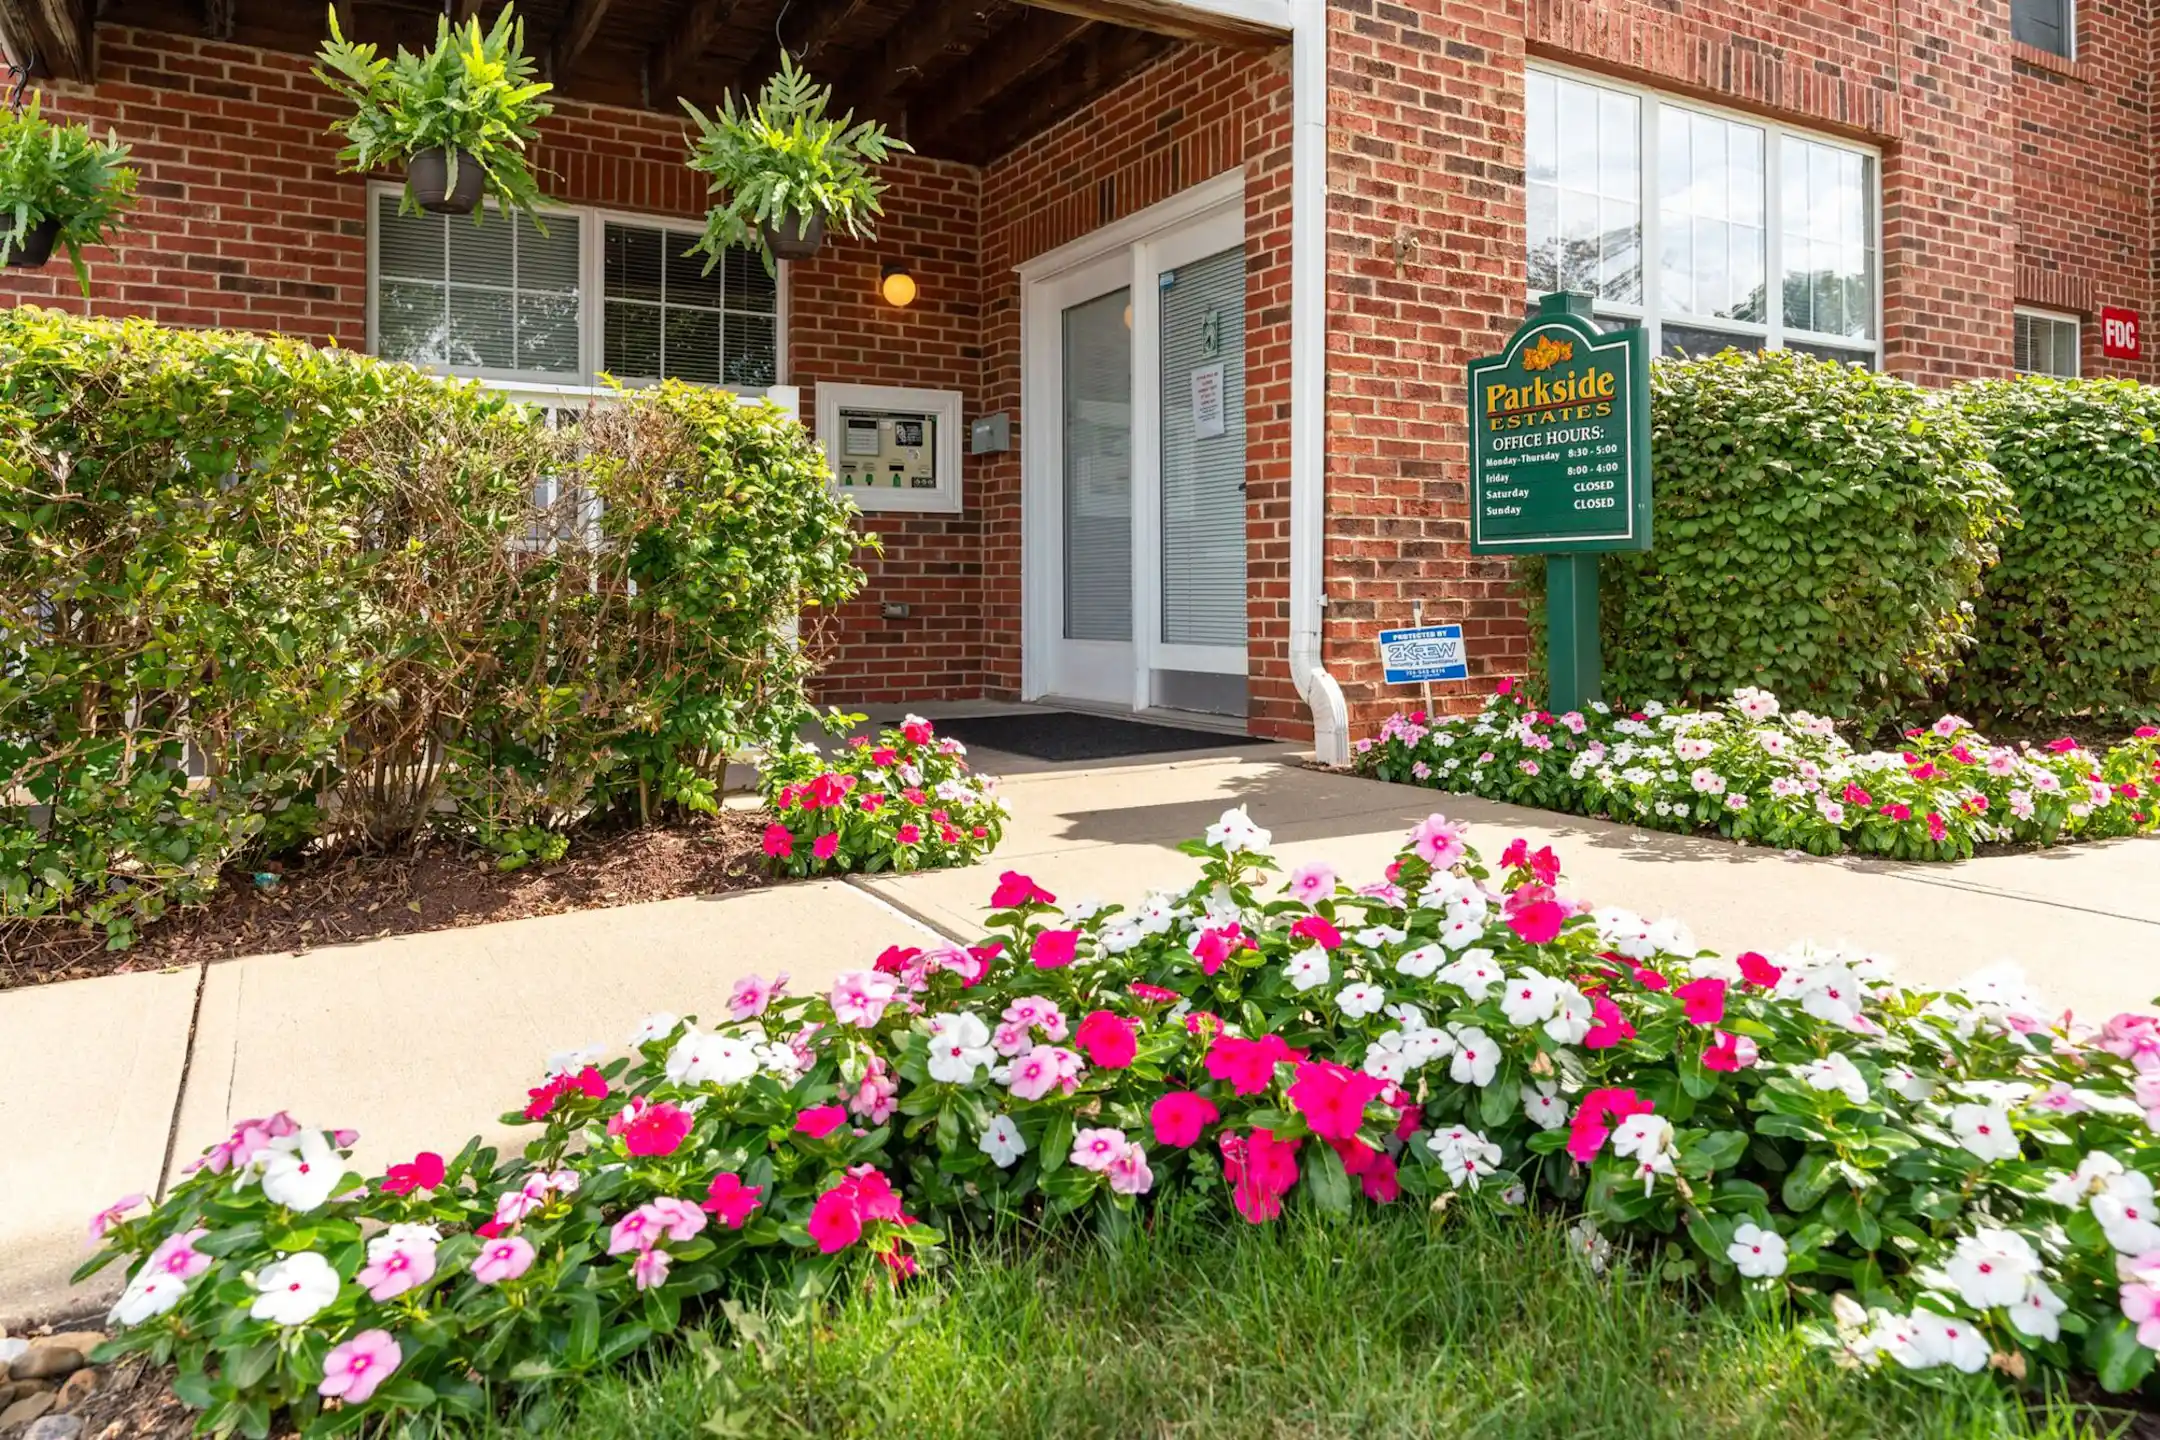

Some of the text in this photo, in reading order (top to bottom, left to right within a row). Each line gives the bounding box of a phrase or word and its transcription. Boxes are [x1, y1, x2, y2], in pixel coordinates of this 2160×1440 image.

[2105, 318, 2136, 350] FDC
[1486, 367, 1616, 413] Parkside
[1490, 402, 1613, 432] ESTATES
[1492, 425, 1605, 451] OFFICE HOURS:
[1485, 451, 1560, 467] Monday-Thursday
[1567, 447, 1589, 458] 8:30
[1596, 444, 1618, 455] 5:00
[1485, 473, 1510, 483] Friday
[1567, 465, 1588, 476] 8:00
[1596, 462, 1619, 473] 4:00
[1485, 480, 1615, 500] Saturday CLOSED
[1486, 497, 1615, 516] Sunday CLOSED
[1392, 631, 1436, 641] PROTECTED
